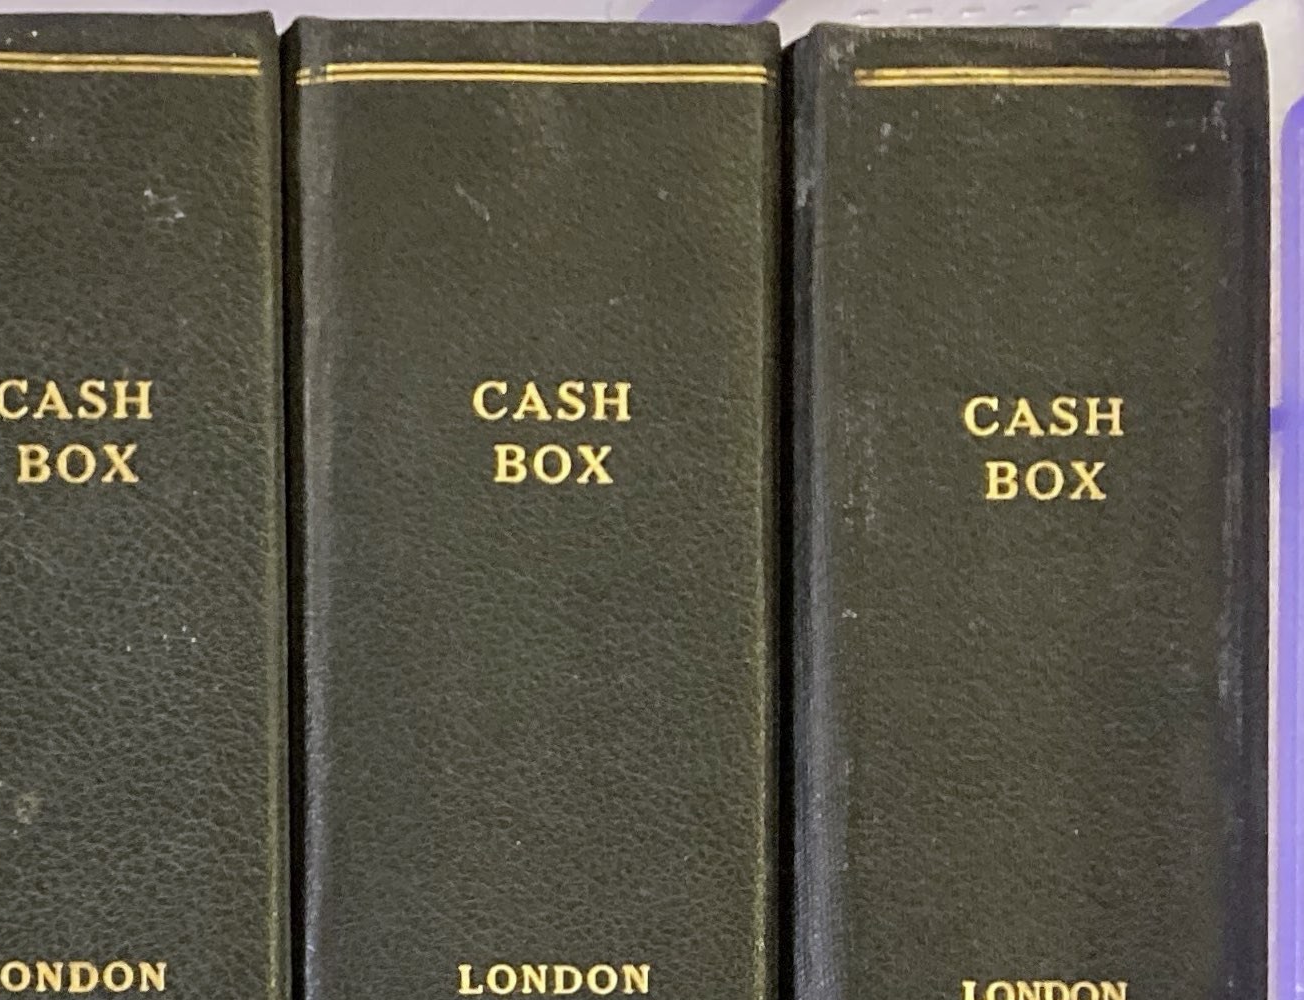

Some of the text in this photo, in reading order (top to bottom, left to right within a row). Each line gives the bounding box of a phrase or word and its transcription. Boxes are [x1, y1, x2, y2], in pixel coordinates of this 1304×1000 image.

[470, 380, 632, 425] CASH
[964, 396, 1124, 438] CASH
[16, 443, 139, 485] BOX
[493, 444, 614, 486] BOX
[986, 460, 1106, 502] BOX
[456, 964, 650, 997] LONDON
